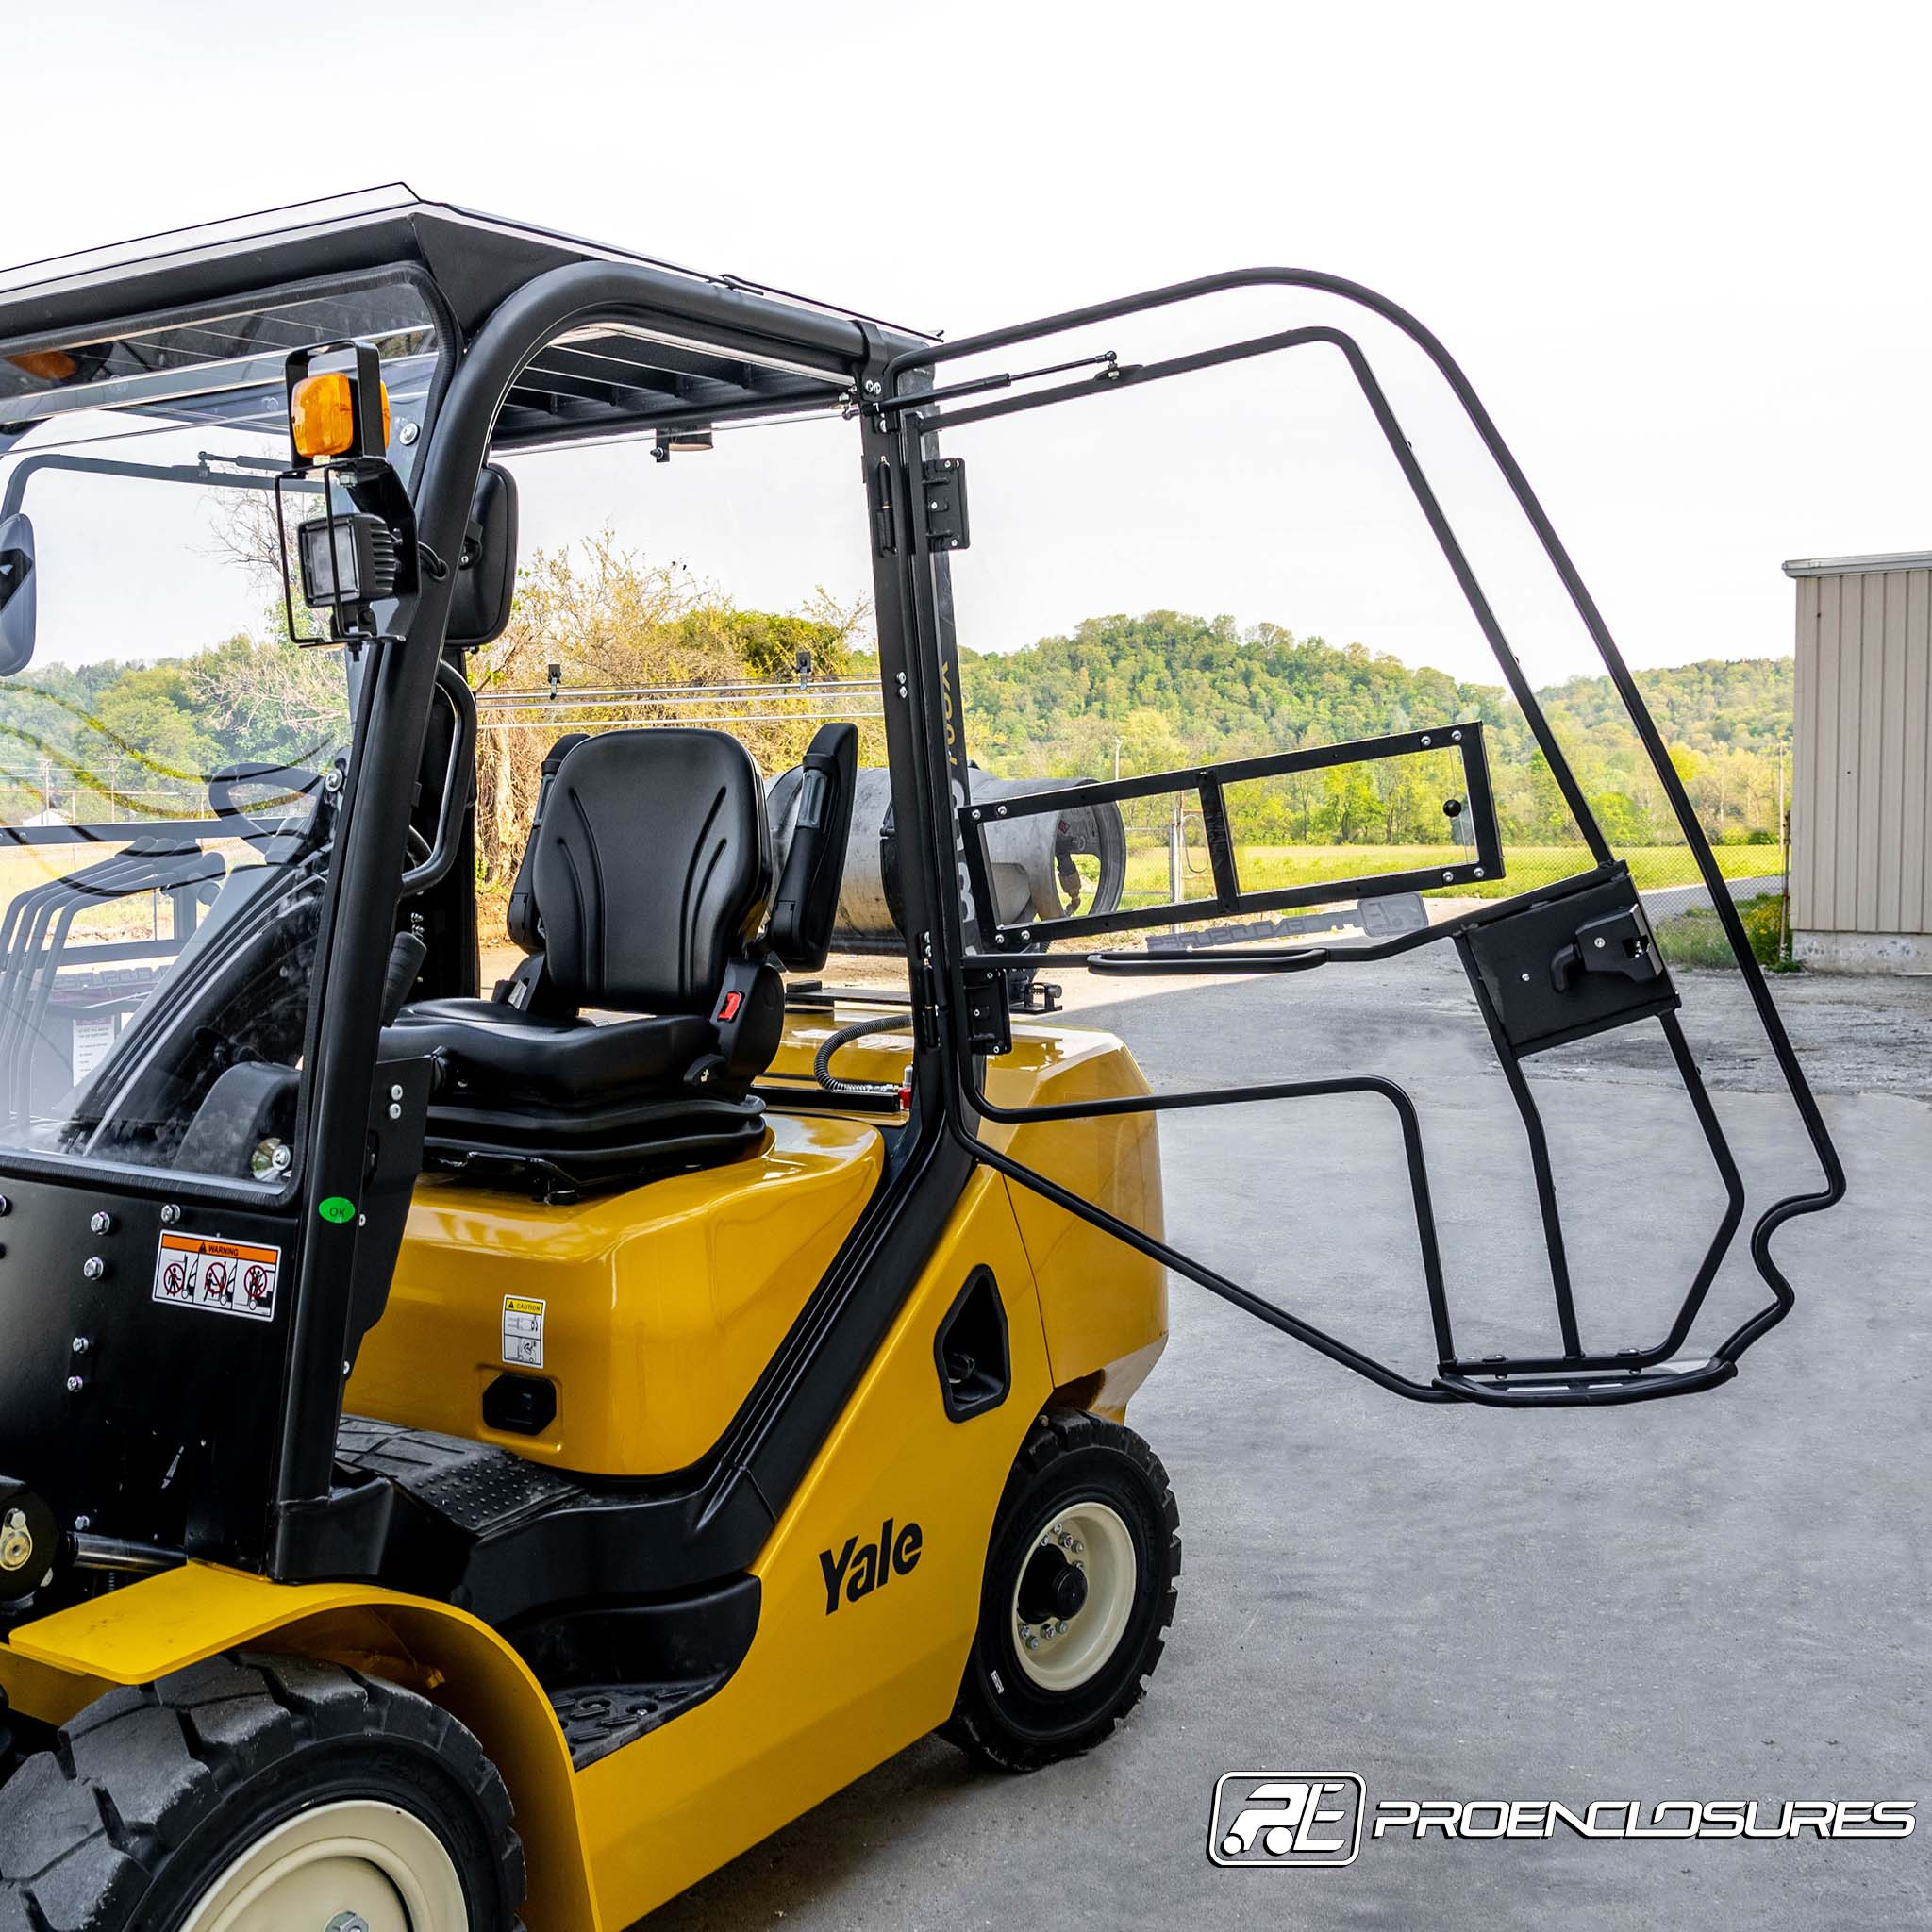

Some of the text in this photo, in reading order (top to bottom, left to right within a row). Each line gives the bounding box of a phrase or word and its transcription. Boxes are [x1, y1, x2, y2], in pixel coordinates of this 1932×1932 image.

[329, 1207, 346, 1218] OK
[208, 1244, 239, 1257] WARNING
[516, 1303, 541, 1311] CAUTION
[819, 1517, 923, 1615] Yale
